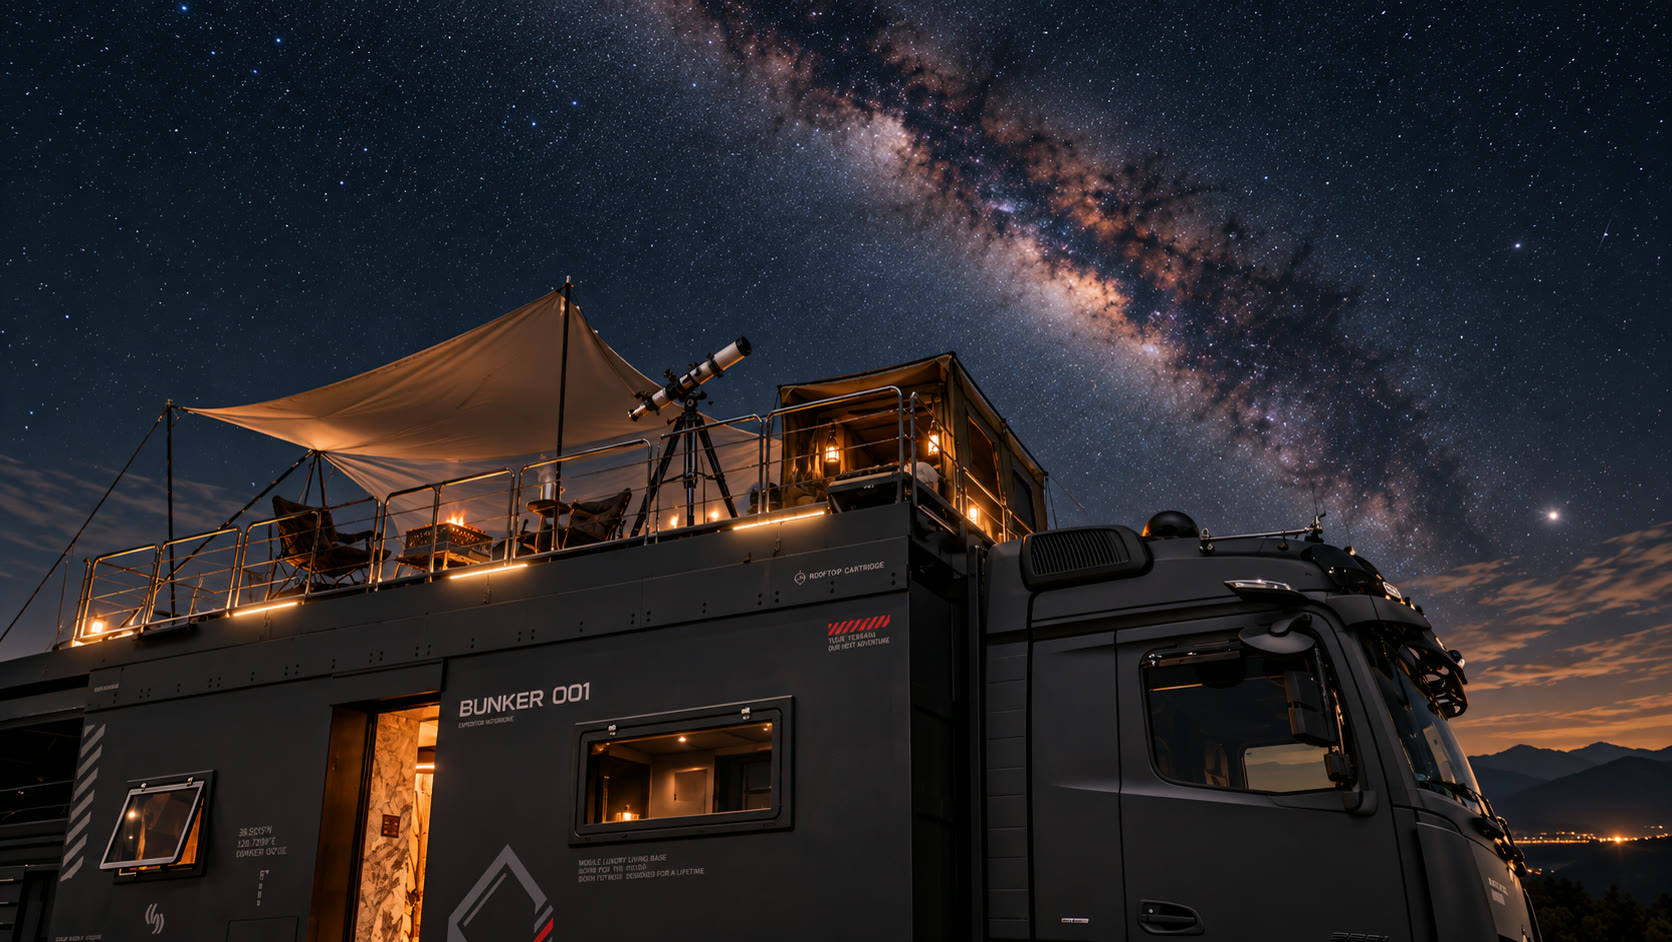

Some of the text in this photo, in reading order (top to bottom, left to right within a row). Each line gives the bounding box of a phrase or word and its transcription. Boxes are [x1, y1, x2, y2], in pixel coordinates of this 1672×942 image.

[809, 561, 885, 580] ROOFTOP CARTRIDGE
[459, 682, 590, 718] BUNKER 001
[650, 853, 668, 862] BASE
[670, 868, 676, 876] A
[676, 867, 705, 876] LIFETIME
